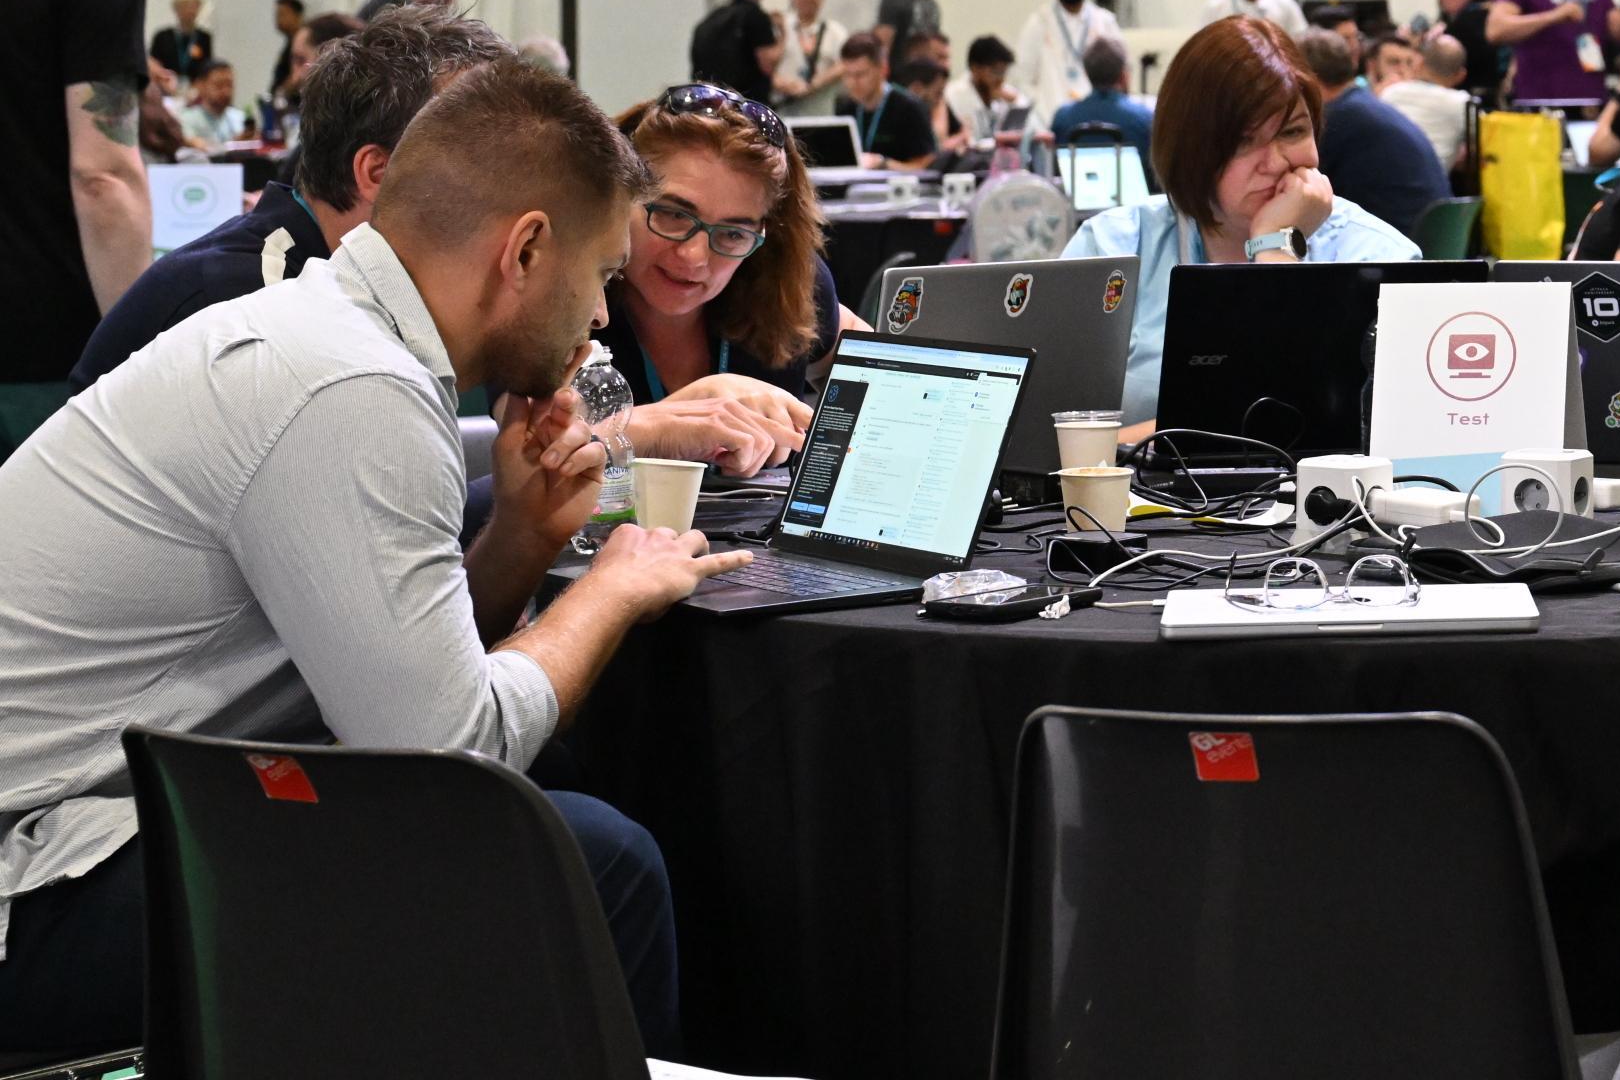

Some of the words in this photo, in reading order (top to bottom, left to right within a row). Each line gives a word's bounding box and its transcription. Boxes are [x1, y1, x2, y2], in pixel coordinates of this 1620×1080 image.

[1583, 297, 1620, 317] 10
[1188, 354, 1229, 366] acer
[1446, 412, 1490, 426] Test
